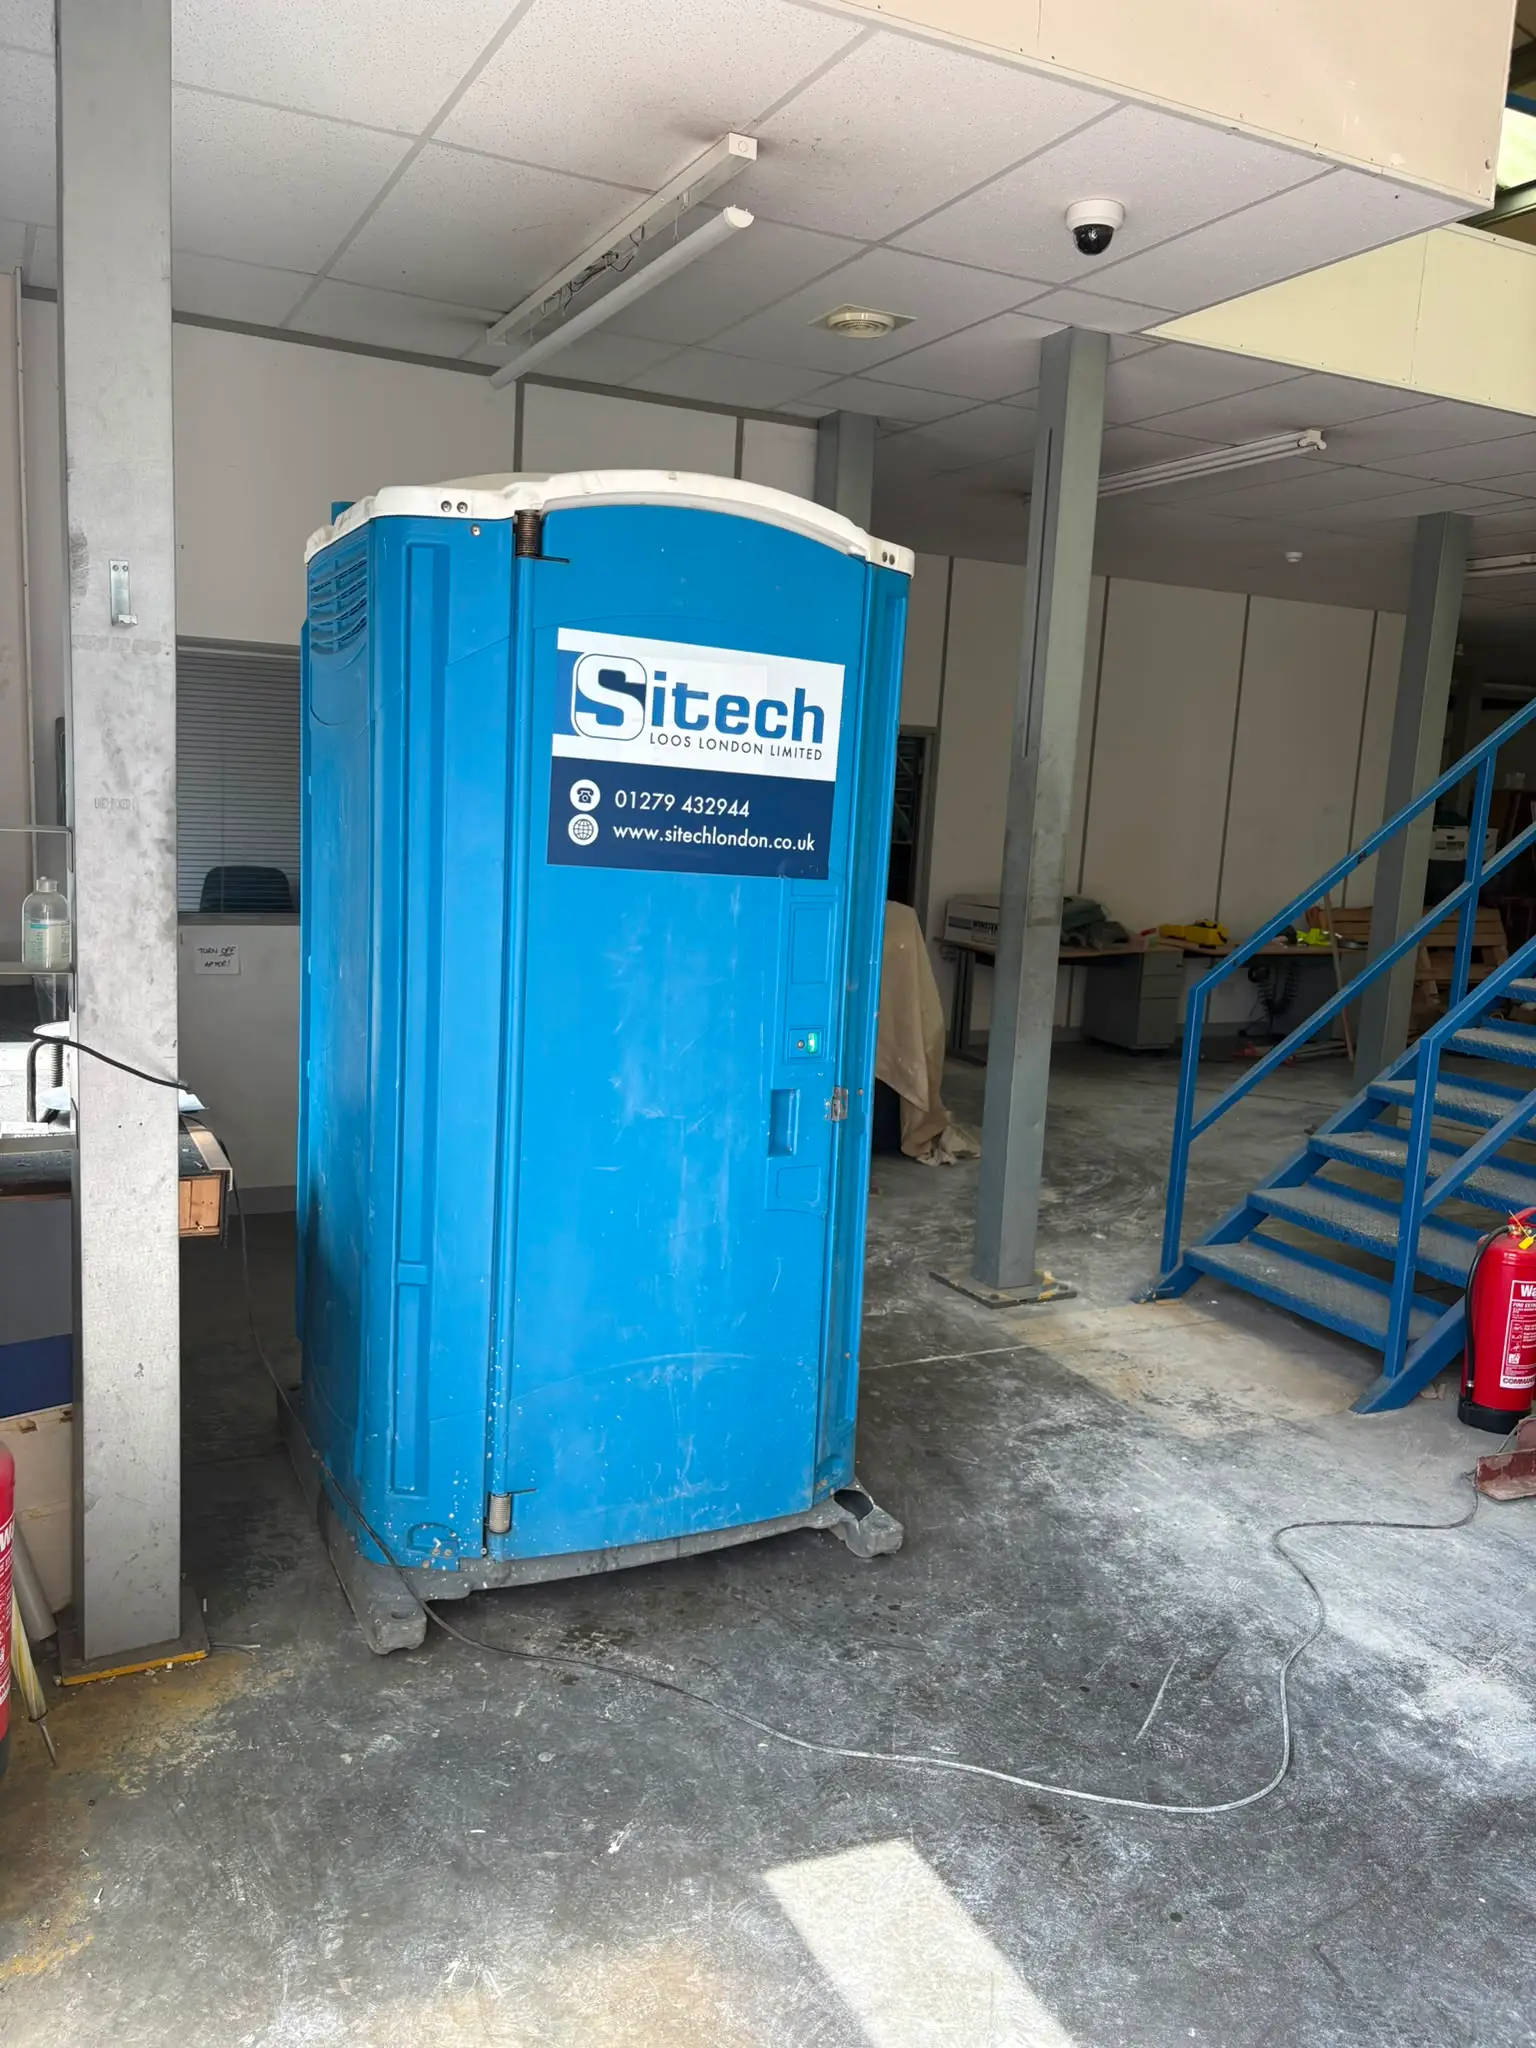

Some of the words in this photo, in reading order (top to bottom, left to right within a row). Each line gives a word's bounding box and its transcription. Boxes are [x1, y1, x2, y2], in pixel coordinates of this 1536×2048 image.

[573, 653, 825, 744] Sitech
[650, 733, 692, 748] LOOS
[699, 738, 763, 755] LONDON
[770, 745, 823, 761] LIMITED
[614, 790, 675, 812] 01279
[681, 796, 750, 818] 432944
[613, 824, 815, 852] www.sitechlondon.co.uk
